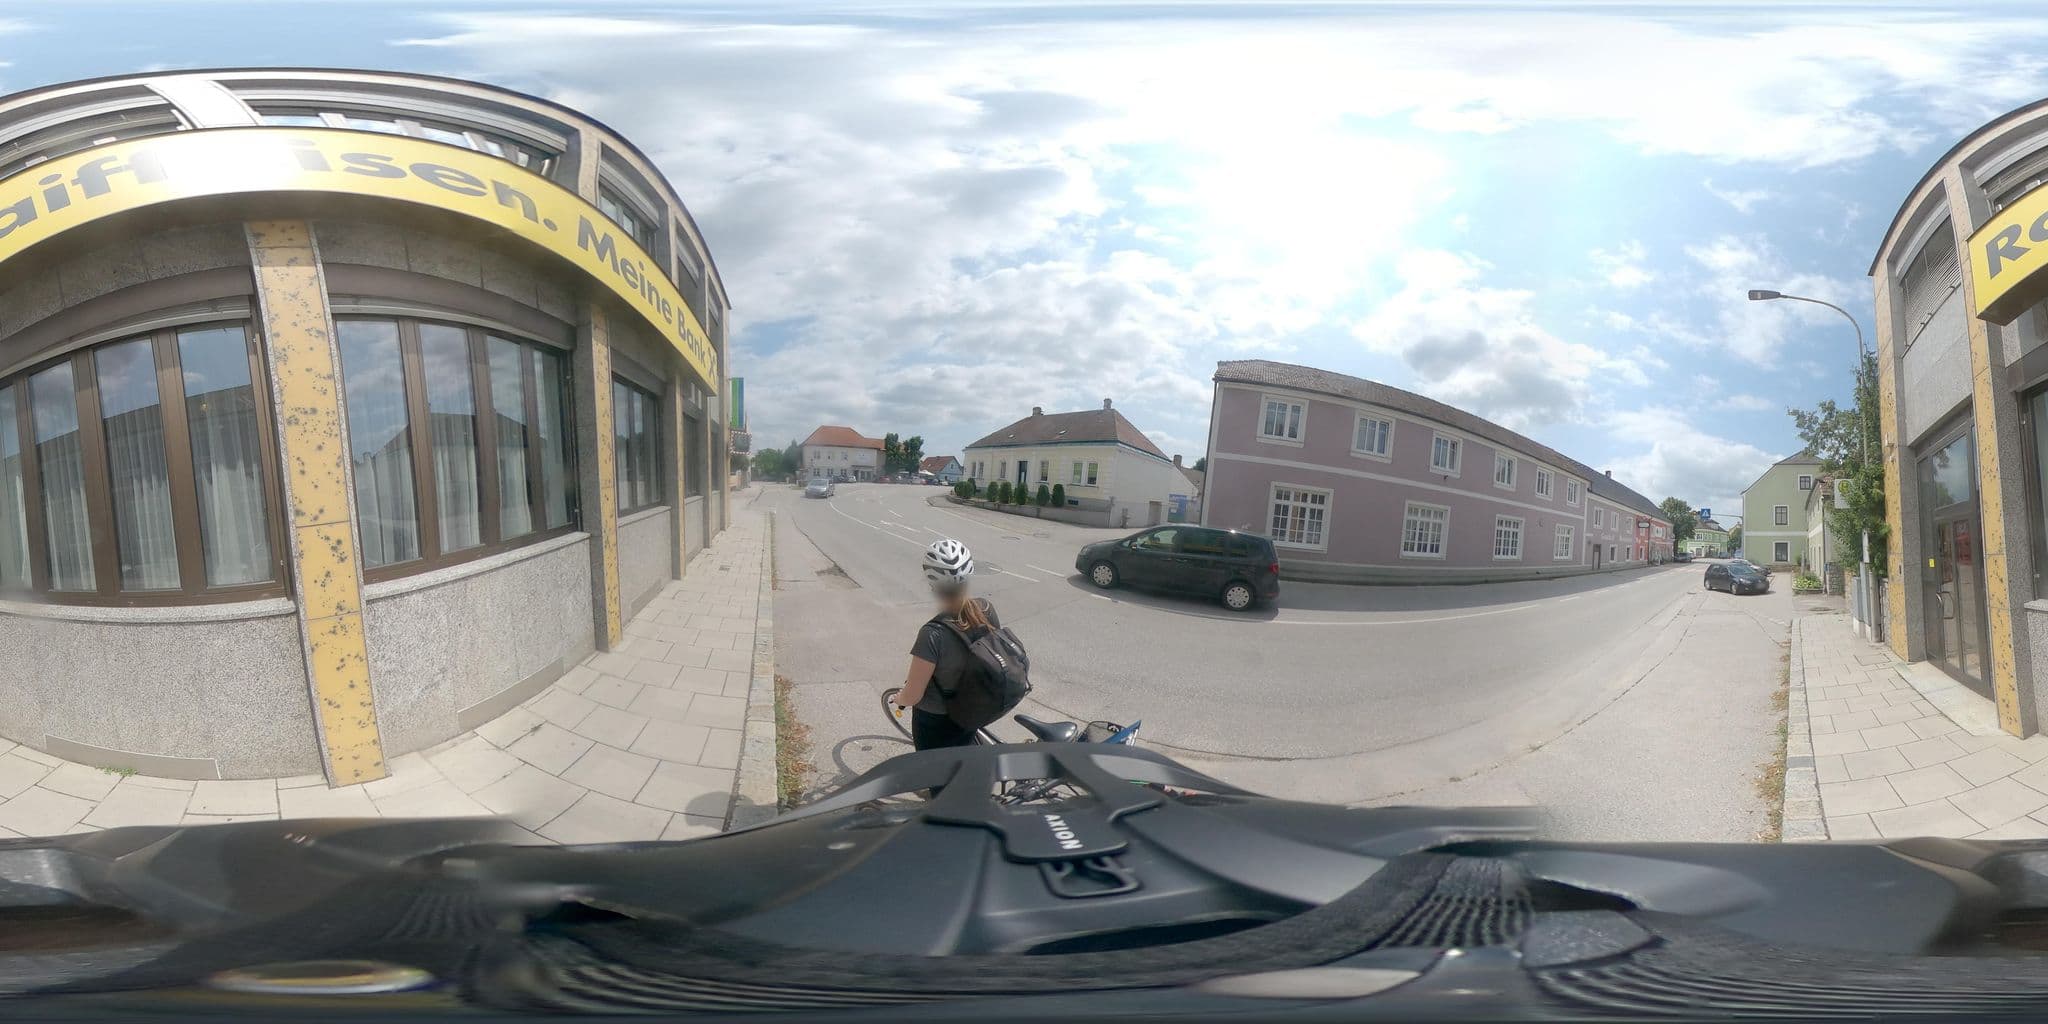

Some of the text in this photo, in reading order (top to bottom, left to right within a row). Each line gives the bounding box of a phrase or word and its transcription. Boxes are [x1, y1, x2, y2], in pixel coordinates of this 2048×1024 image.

[577, 214, 672, 325] Meine
[677, 306, 706, 368] Bank
[1044, 814, 1083, 849] AXION
